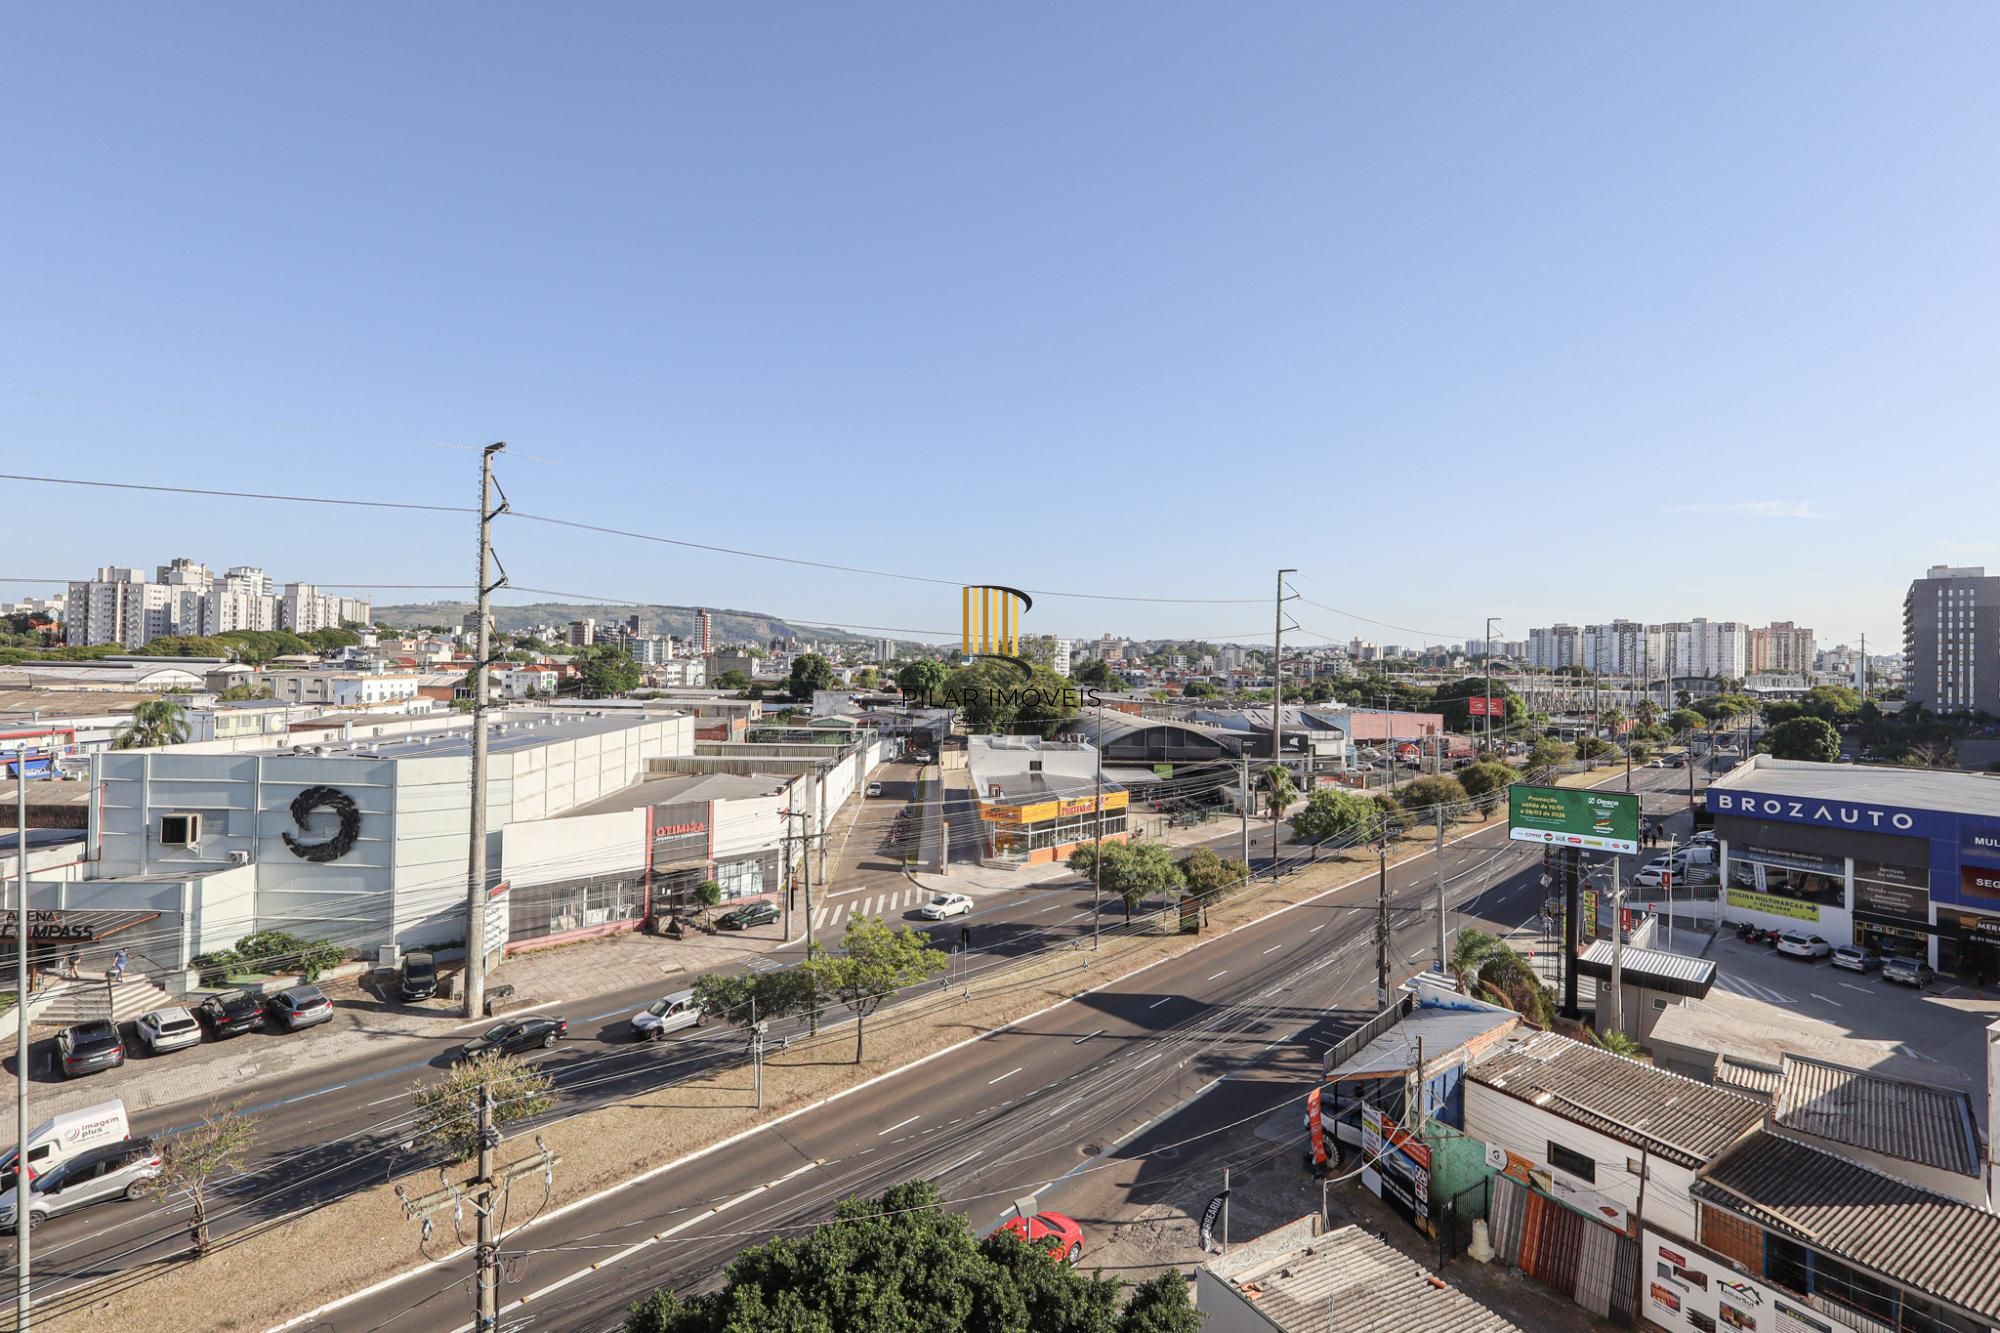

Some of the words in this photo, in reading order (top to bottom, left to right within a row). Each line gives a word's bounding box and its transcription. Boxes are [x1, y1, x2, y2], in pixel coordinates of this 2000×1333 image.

[1596, 798, 1619, 806] Desco
[1728, 890, 1754, 900] OFICINA
[1755, 895, 1804, 909] MULTIMARCAS
[7, 911, 57, 921] AENA
[1, 924, 94, 940] CMPASS
[81, 1116, 119, 1131] imagem
[81, 1127, 103, 1138] plus
